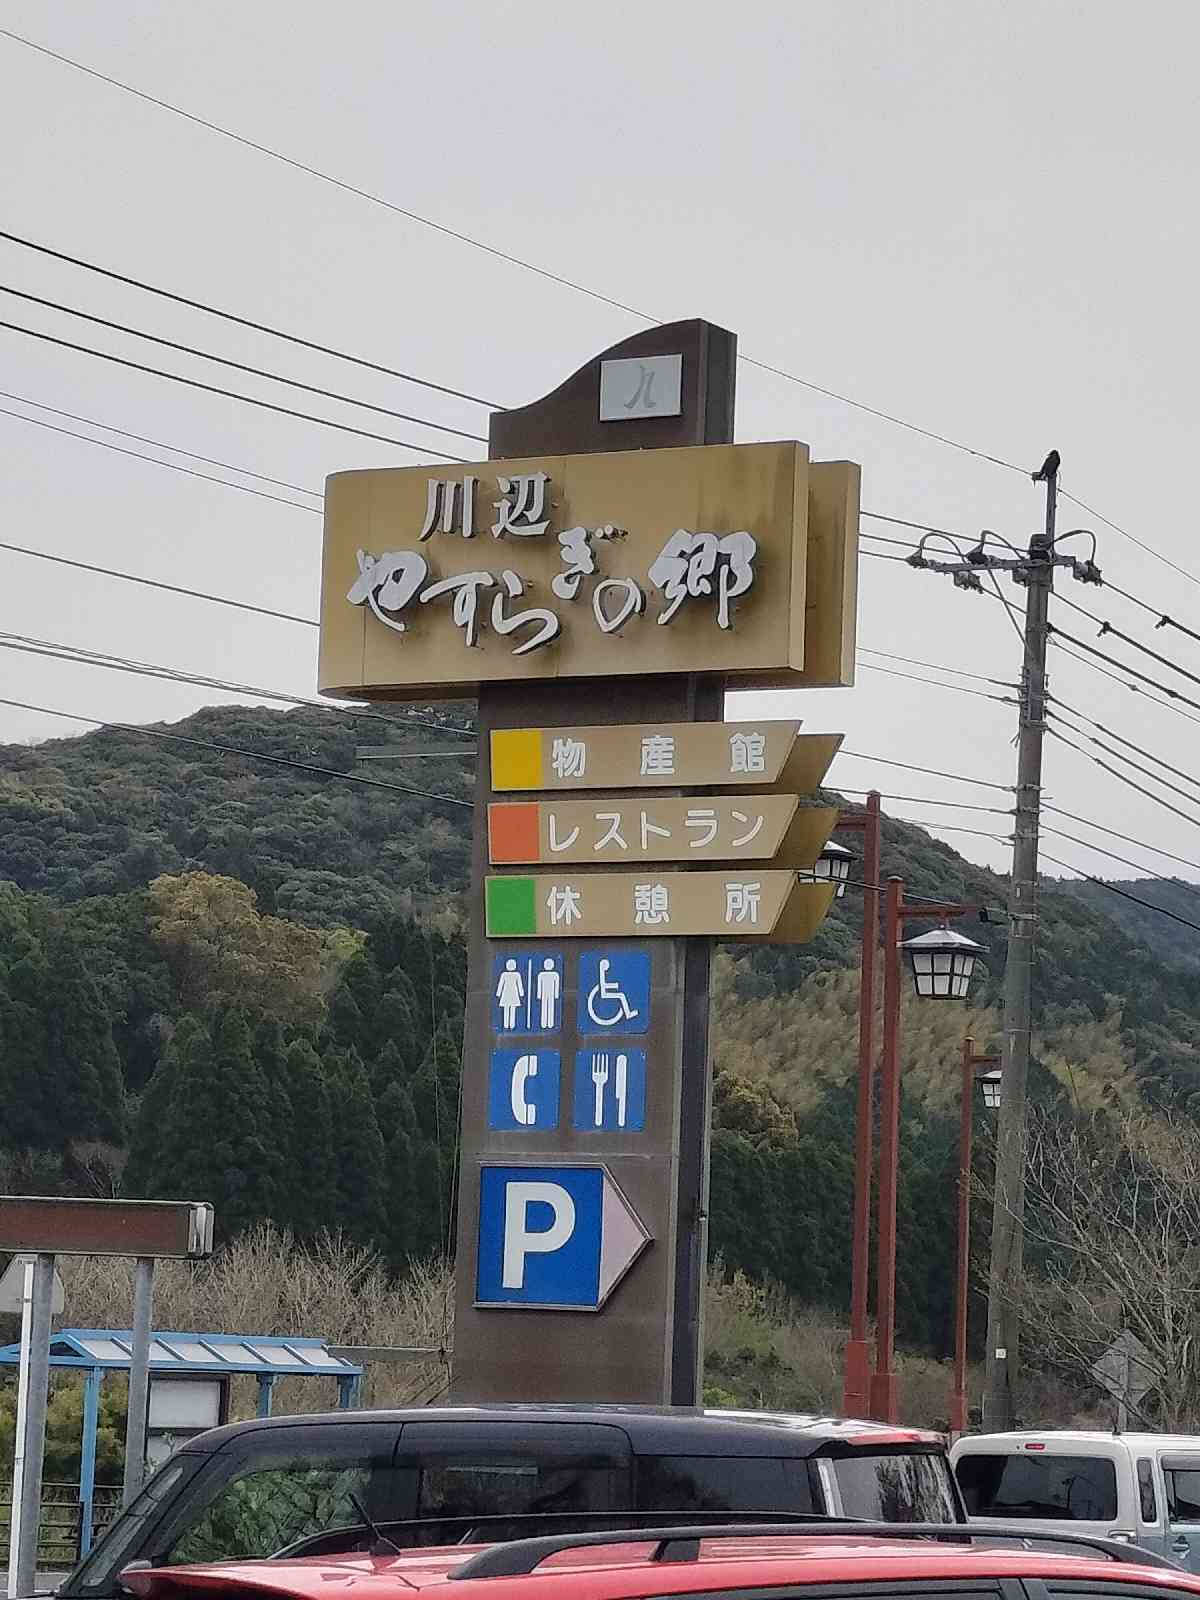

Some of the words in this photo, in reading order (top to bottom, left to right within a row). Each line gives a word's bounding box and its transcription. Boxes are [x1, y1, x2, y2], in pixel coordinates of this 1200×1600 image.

[419, 473, 550, 541] 川辺
[347, 528, 757, 655] やすらぎの郷
[552, 733, 766, 778] 物産館
[549, 810, 763, 851] レストラン
[547, 882, 761, 926] 休憩所
[502, 1182, 576, 1289] P
